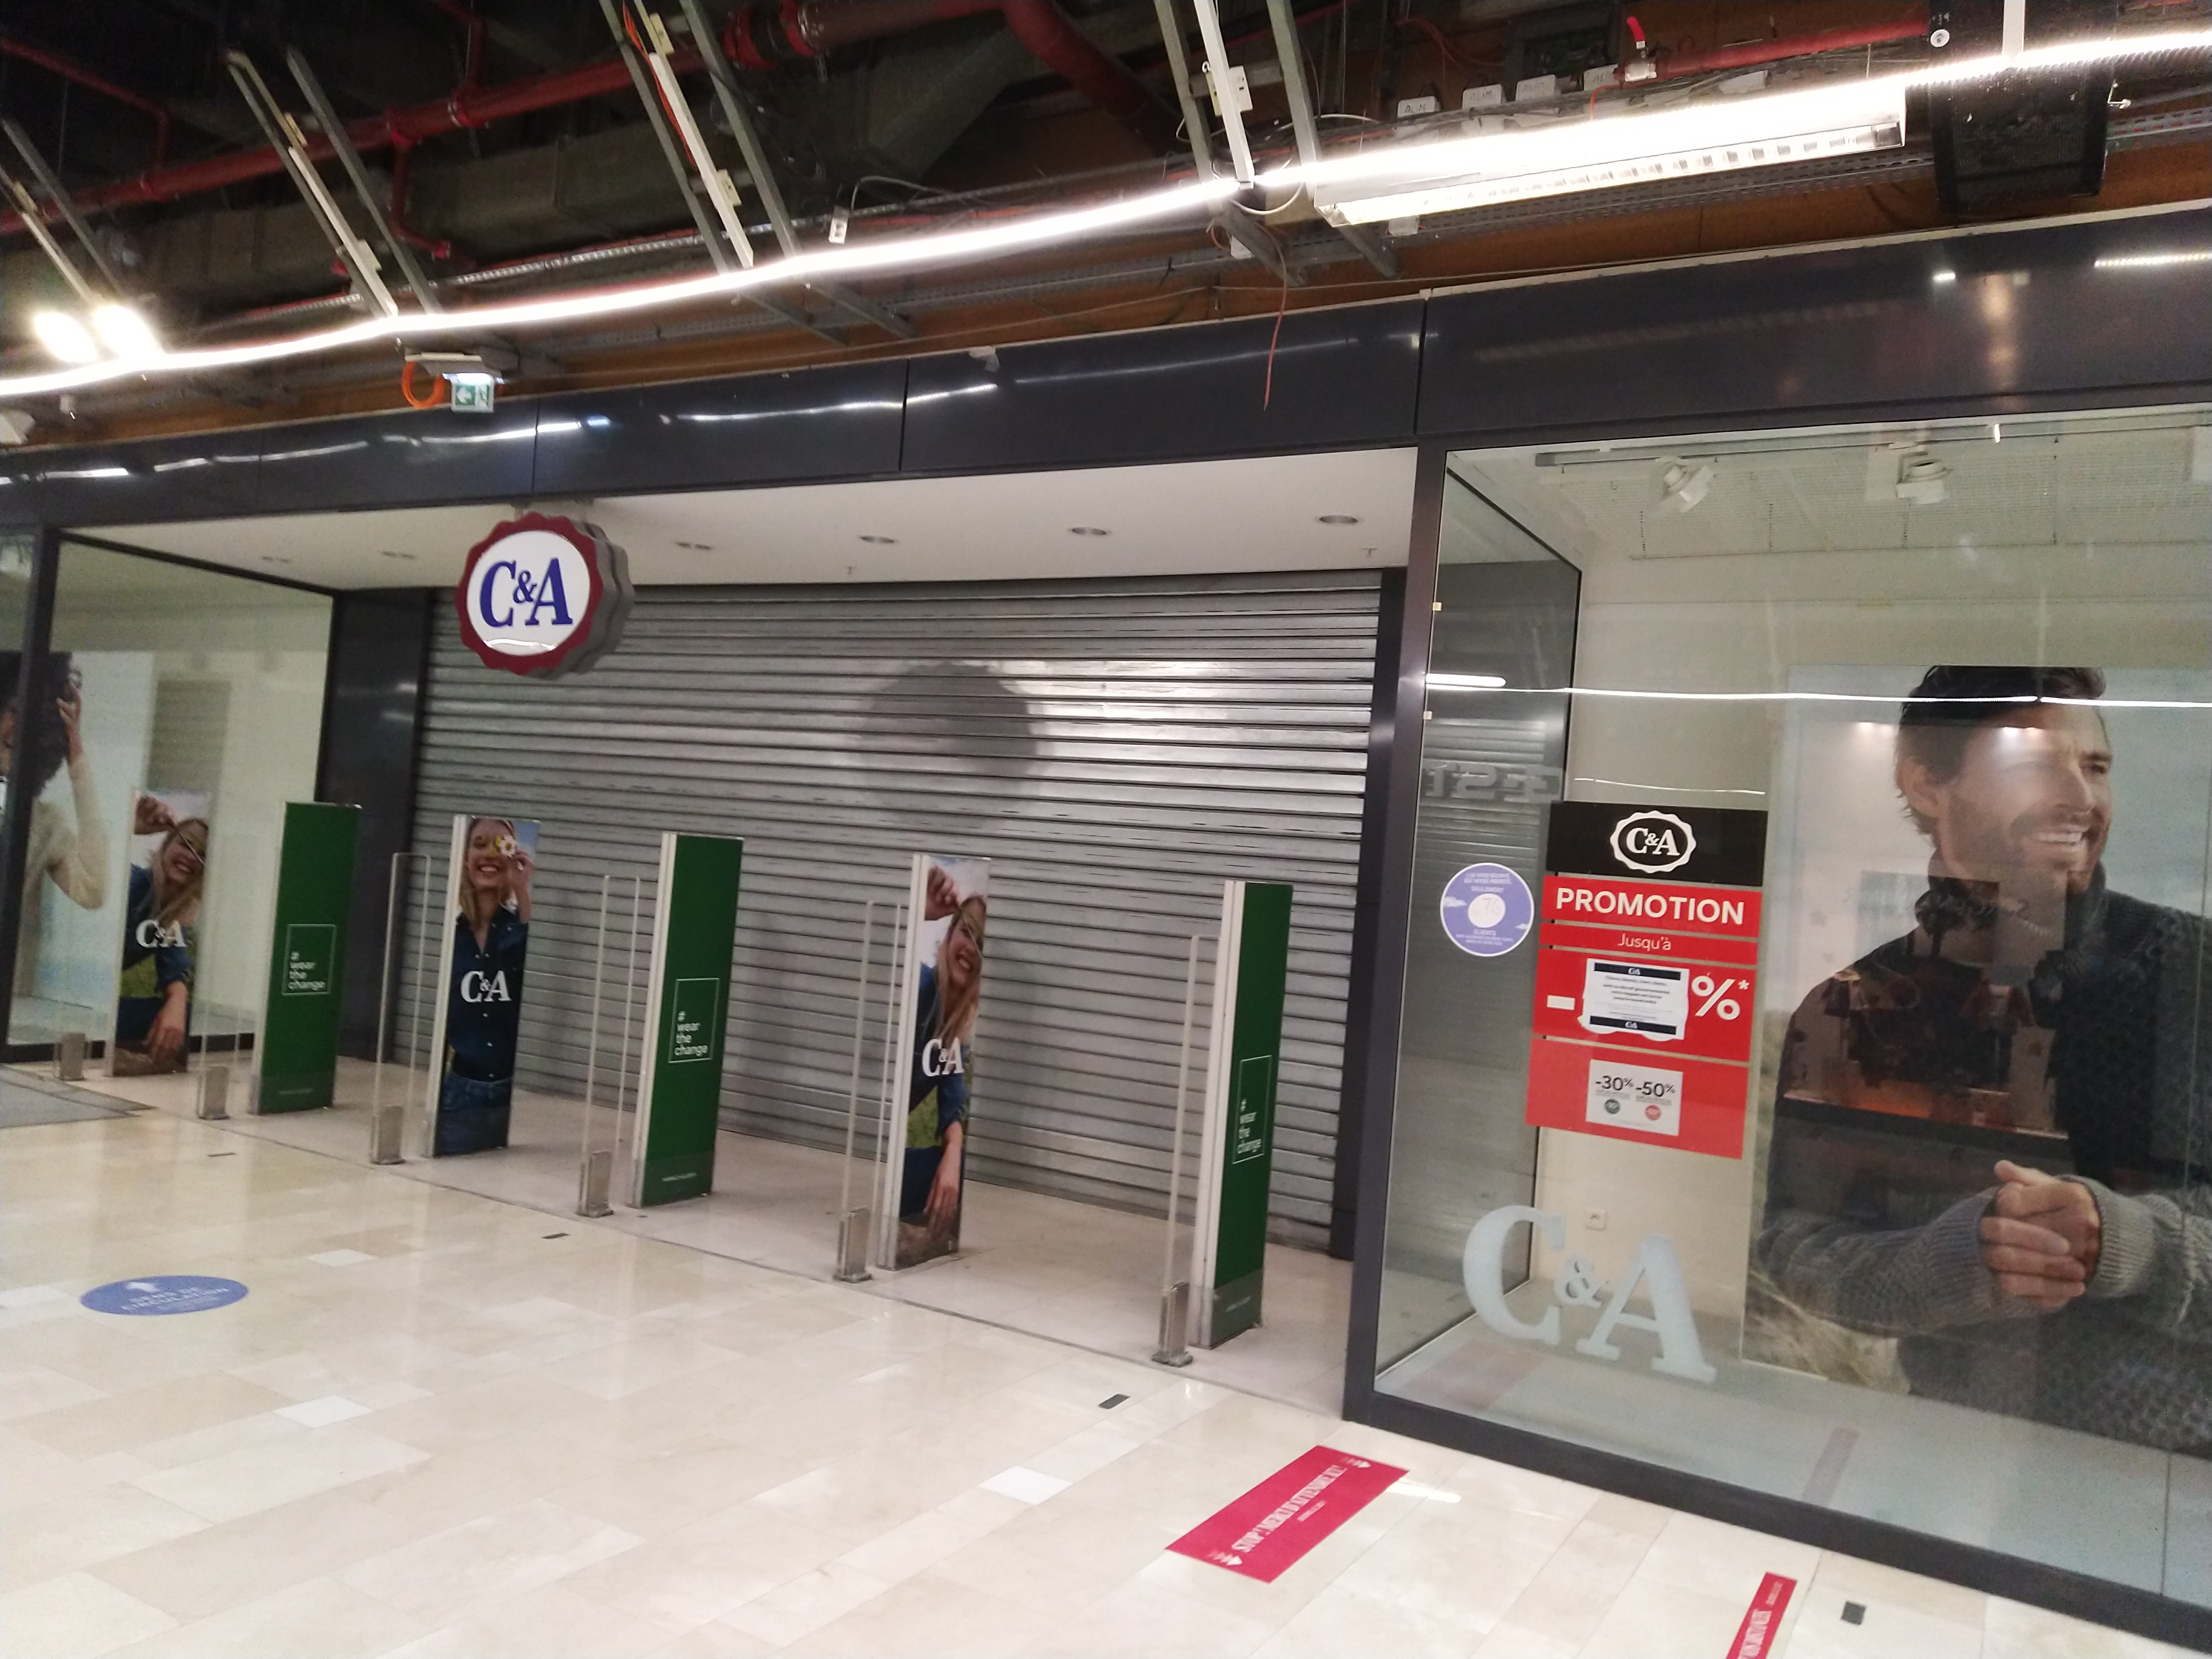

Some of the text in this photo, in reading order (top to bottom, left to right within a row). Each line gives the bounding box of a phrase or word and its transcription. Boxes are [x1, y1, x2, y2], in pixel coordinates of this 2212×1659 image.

[480, 557, 573, 627] C&A
[1627, 827, 1680, 856] C&A
[1556, 886, 1745, 925] PROMOTION
[136, 919, 187, 948] C&A
[1618, 933, 1672, 952] Jusqu'à
[288, 979, 326, 992] change
[460, 970, 512, 1003] C&A
[676, 1032, 692, 1044] the
[677, 1023, 701, 1032] wear
[674, 1044, 709, 1057] change
[922, 1037, 965, 1076] C&A
[1595, 1075, 1633, 1091] -30%
[1636, 1081, 1675, 1097] -50%
[1237, 1138, 1261, 1154] change
[1463, 1205, 1716, 1382] C&A
